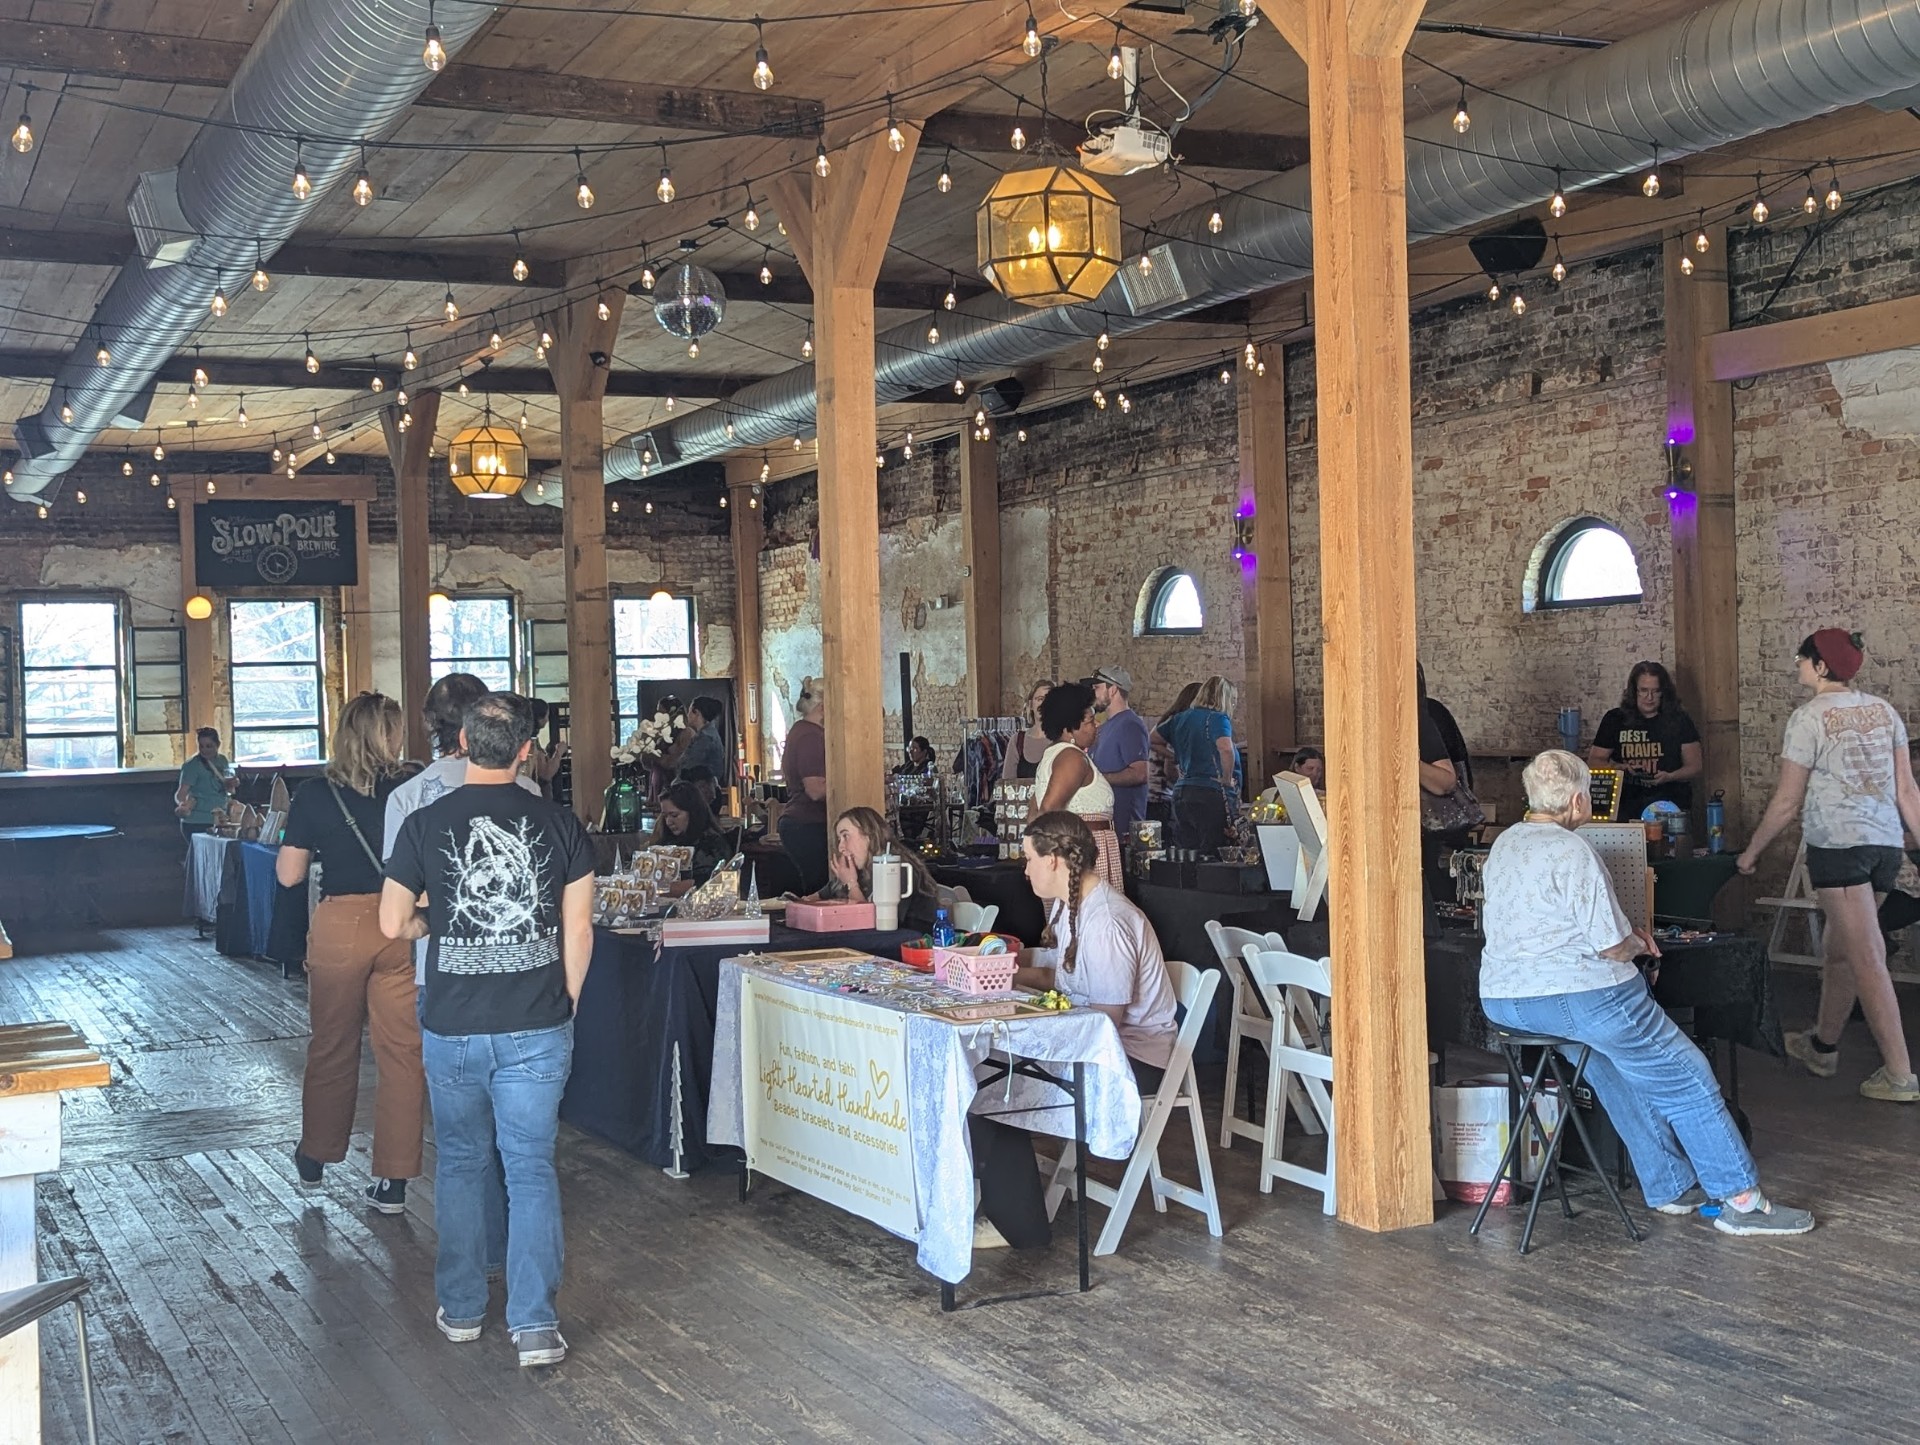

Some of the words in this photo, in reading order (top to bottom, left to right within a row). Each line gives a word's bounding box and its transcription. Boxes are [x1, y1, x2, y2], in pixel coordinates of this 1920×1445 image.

[211, 517, 274, 554] SLOW
[276, 511, 339, 546] POUR
[297, 540, 336, 551] BREWING
[1621, 742, 1664, 758] TRAVEL
[440, 935, 518, 947] WORLDWIDE
[779, 1041, 792, 1058] Fun,
[794, 1046, 820, 1068] fashion,
[823, 1058, 836, 1071] and
[839, 1060, 856, 1077] faith
[837, 1081, 907, 1132] Handmade
[774, 1099, 799, 1118] Beaded
[802, 1107, 834, 1132] bracelets
[837, 1124, 850, 1138] and
[854, 1130, 898, 1156] accessories
